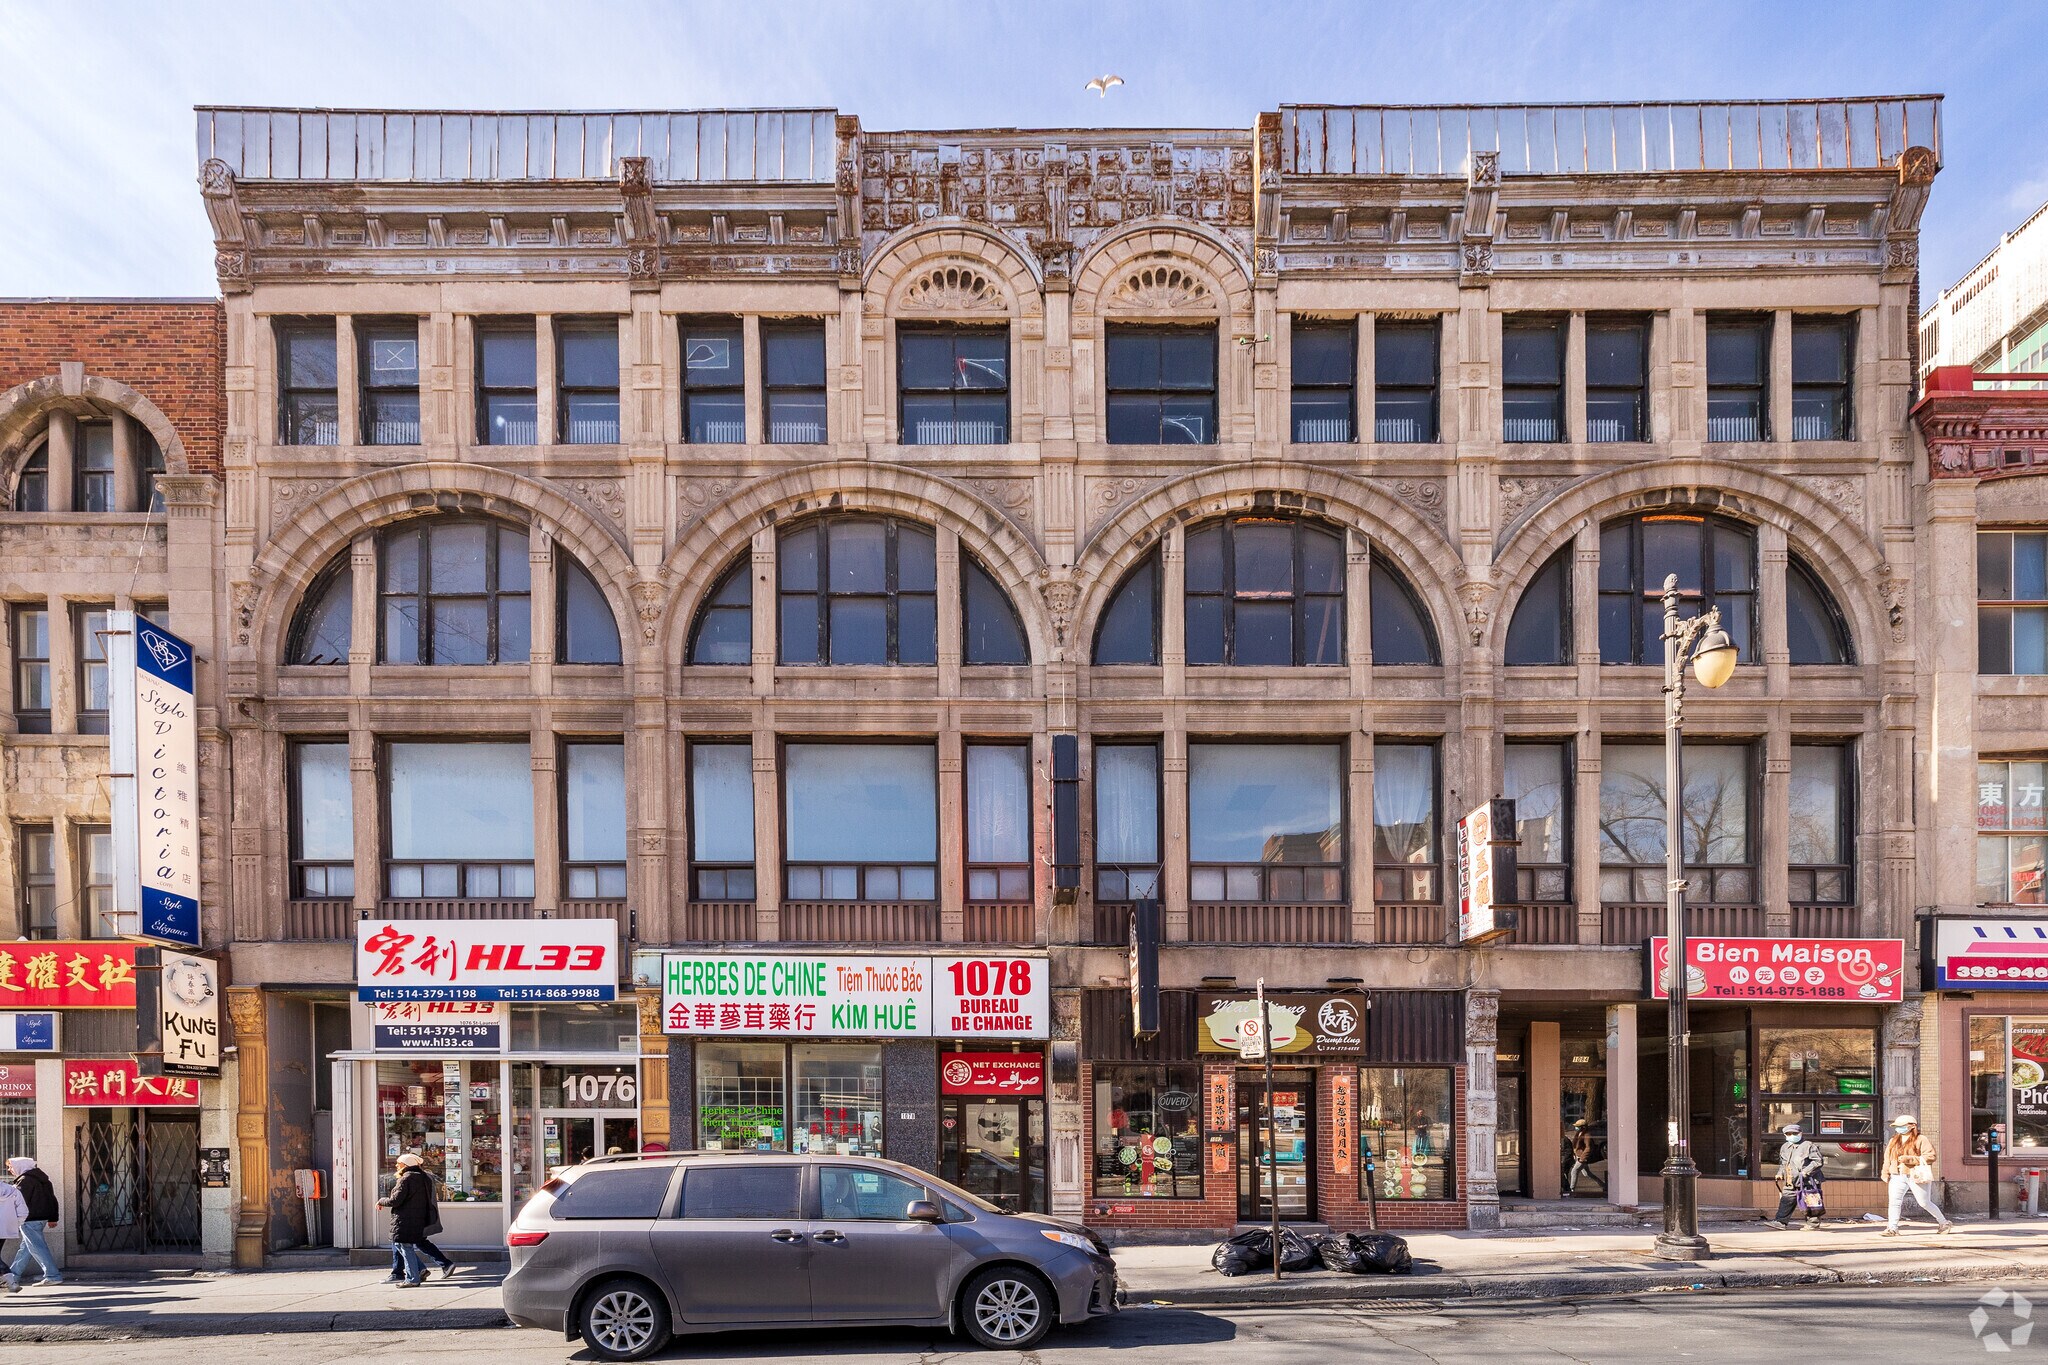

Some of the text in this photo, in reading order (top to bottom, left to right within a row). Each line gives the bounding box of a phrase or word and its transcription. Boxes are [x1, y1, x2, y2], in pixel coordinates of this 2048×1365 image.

[140, 689, 188, 719] Stylo
[1979, 782, 2045, 807] 東方
[159, 897, 183, 911] Style
[464, 945, 606, 971] HL33
[1696, 942, 1871, 963] Bien Maison
[668, 961, 827, 997] HERBES DE CHINE
[947, 960, 1032, 996] 1078
[1731, 967, 1824, 983] 小笼包子
[374, 989, 477, 998] Tel: 514-379-1198
[498, 988, 600, 998] Tel: 514-868-9988
[1747, 986, 1846, 997] 514-875-1888
[874, 998, 917, 1030] HUÊ
[960, 998, 1019, 1014] BUREAU
[1265, 1000, 1308, 1015] iang
[164, 1011, 217, 1037] KUNG
[387, 1026, 488, 1036] Tel: 514-379-1198
[951, 1015, 1033, 1031] DE CHANGE
[402, 1037, 474, 1047] www.hl33.ca
[1316, 1034, 1361, 1046] Dumpling
[179, 1038, 206, 1060] FU
[562, 1075, 636, 1102] 1076
[1160, 1096, 1190, 1106] OUVERT
[700, 1106, 736, 1115] Herbes
[754, 1106, 783, 1115] Chine
